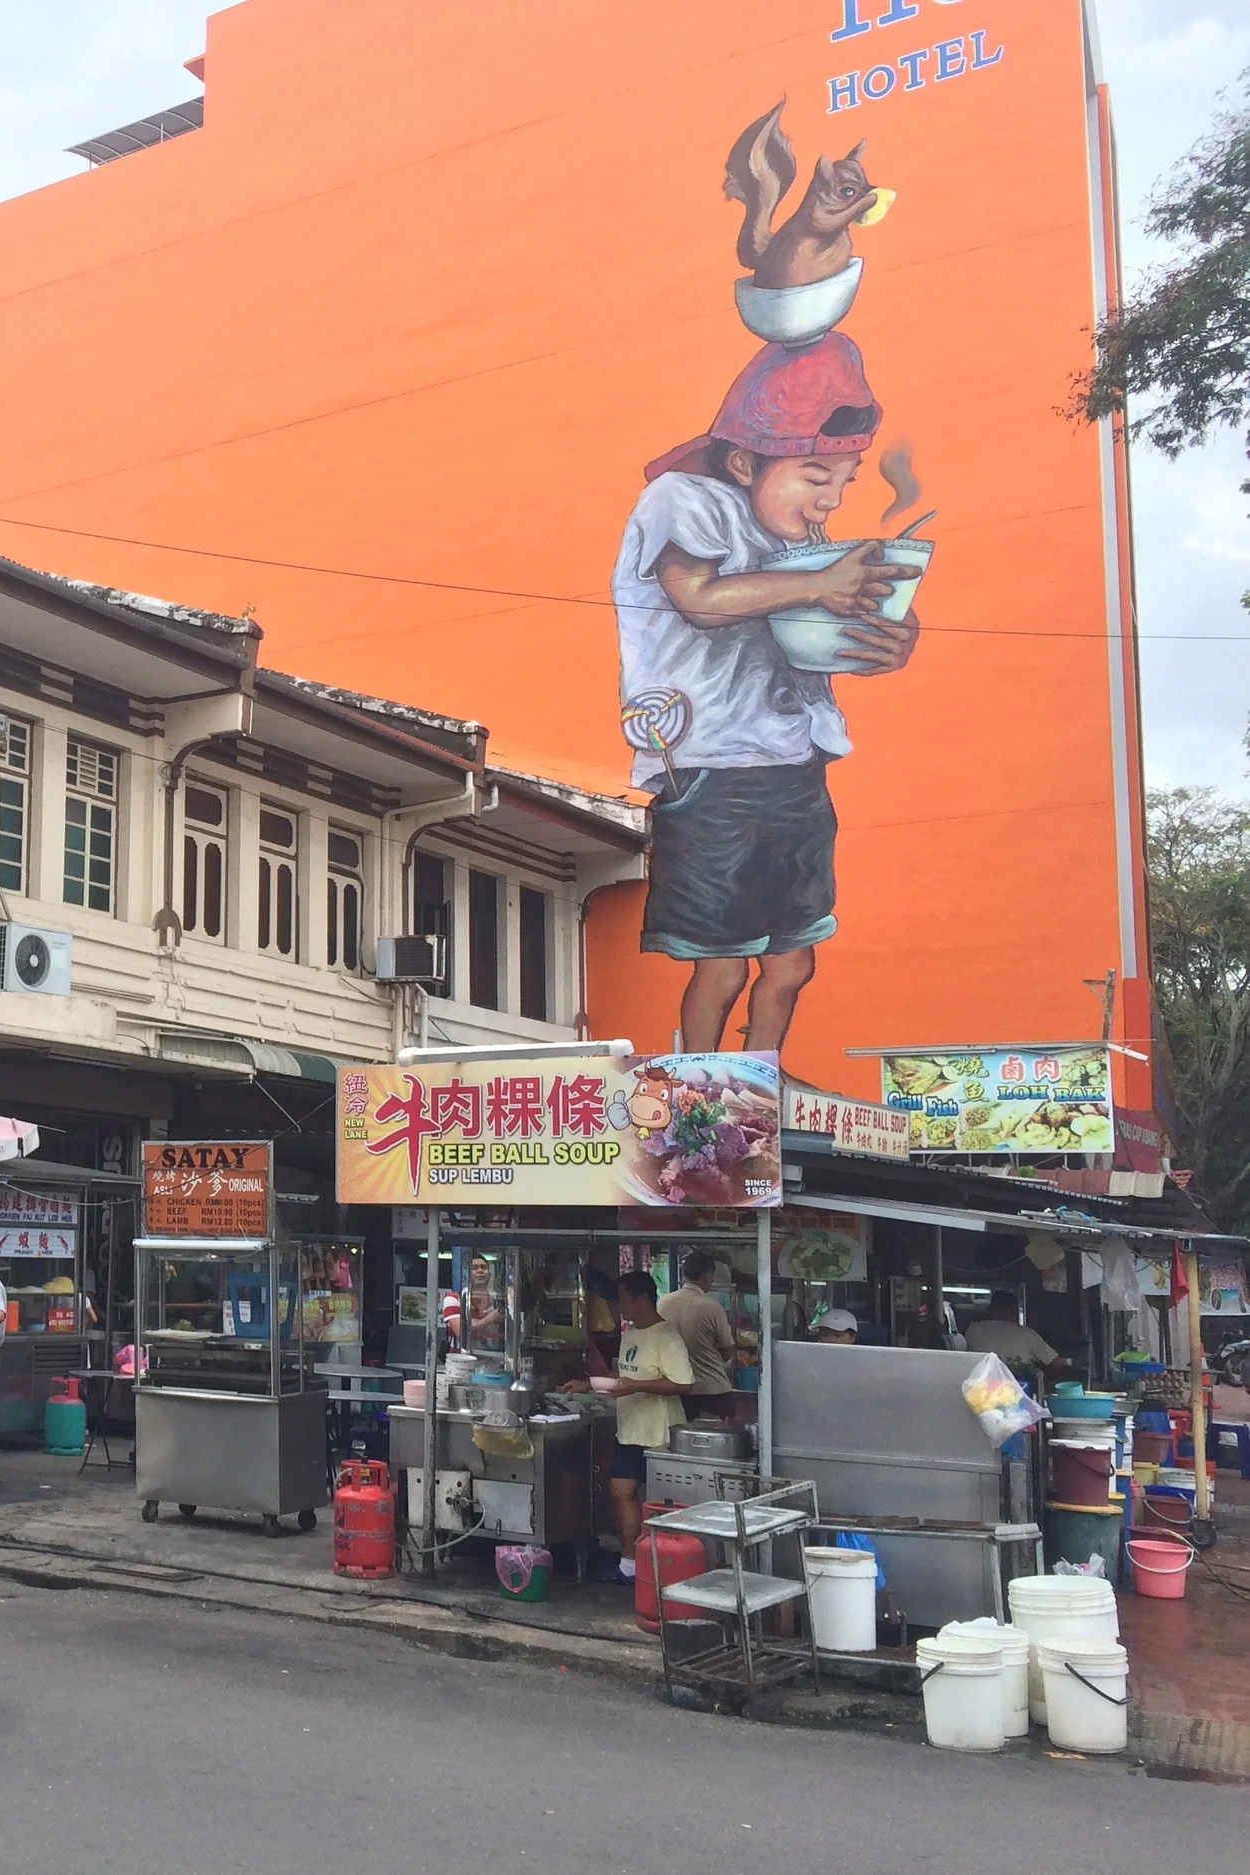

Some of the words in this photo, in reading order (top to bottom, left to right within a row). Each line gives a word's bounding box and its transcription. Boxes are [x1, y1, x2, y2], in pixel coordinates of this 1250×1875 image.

[827, 29, 1004, 114] HOTEL
[997, 1085, 1050, 1101] LOH
[1053, 1086, 1106, 1103] BAK
[887, 1091, 923, 1111] Grill
[925, 1096, 960, 1117] Fish
[344, 1118, 365, 1128] NEW
[854, 1107, 871, 1127] BEEF
[873, 1111, 889, 1131] BALL
[891, 1114, 907, 1134] SOUP
[344, 1130, 368, 1140] LANE
[364, 1072, 607, 1198] 牛肉粿條
[161, 1147, 250, 1169] SATAY
[428, 1143, 485, 1165] BEEF
[490, 1143, 549, 1165] BALL
[554, 1142, 620, 1164] SOUP
[180, 1169, 229, 1197] 沙爹
[428, 1168, 460, 1184] SUP
[461, 1168, 513, 1184] LEMBU
[744, 1179, 772, 1187] SINCE
[228, 1178, 264, 1192] ORIGINAL
[745, 1187, 772, 1196] 1969
[166, 1199, 202, 1207] CHICKEN
[22, 1213, 33, 1221] PAI
[34, 1213, 46, 1221] KUT
[48, 1214, 59, 1222] LOR
[61, 1214, 73, 1222] MEE
[166, 1207, 187, 1215] BEEF
[201, 1207, 233, 1216] RM10.00
[166, 1217, 189, 1225] LAMB
[201, 1217, 233, 1226] RM12.00
